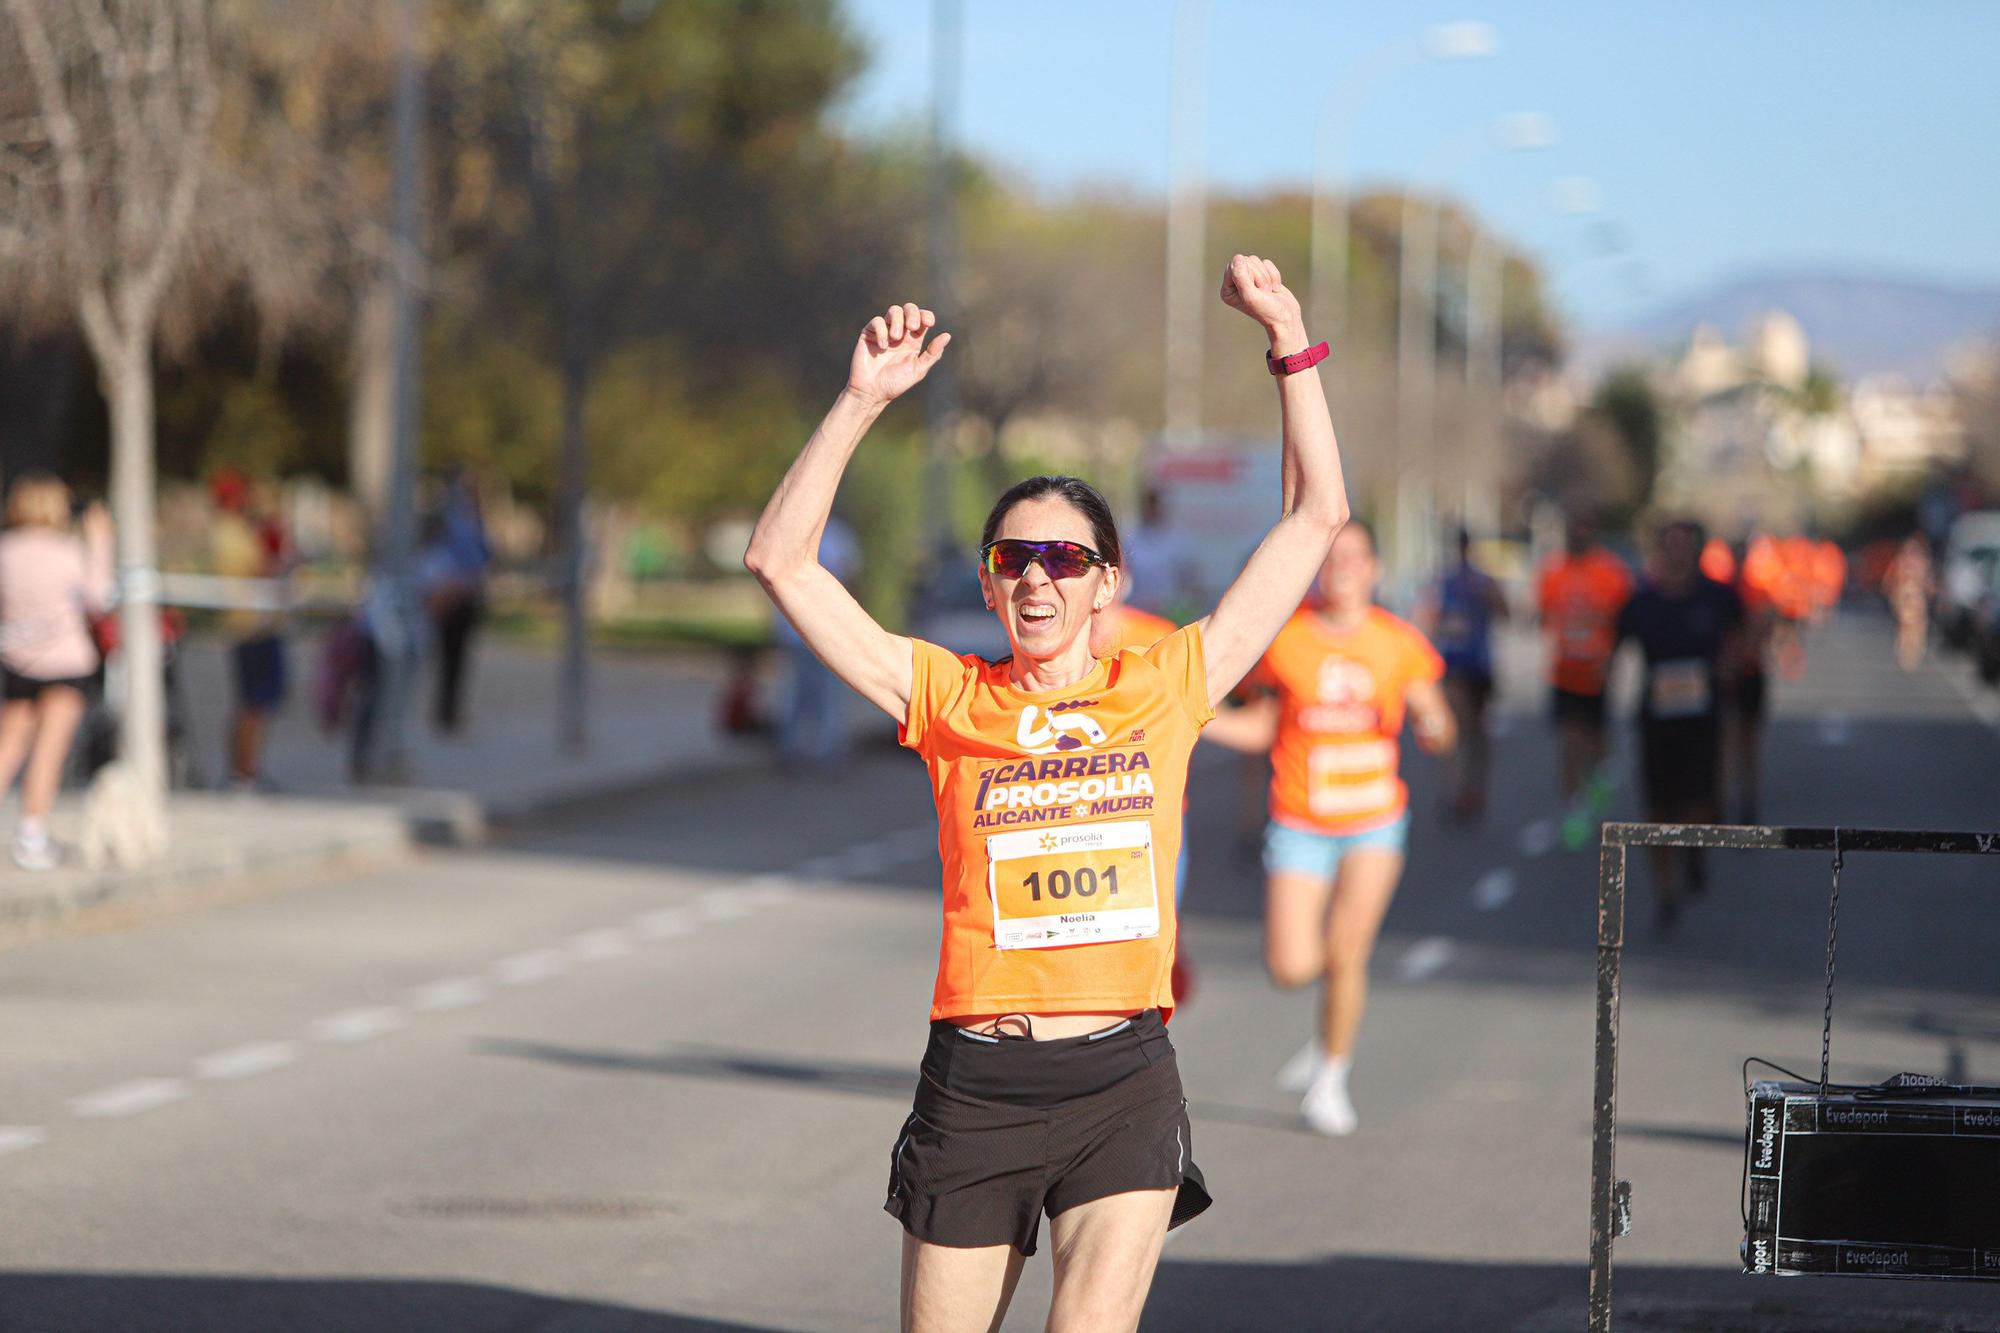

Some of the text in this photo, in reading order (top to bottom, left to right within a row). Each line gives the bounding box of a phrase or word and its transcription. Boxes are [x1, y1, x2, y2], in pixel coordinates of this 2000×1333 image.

[994, 751, 1151, 785] CARRERA
[986, 773, 1154, 811] PROSOLIA
[973, 796, 1154, 829] ALICANTE MUJER
[1060, 832, 1103, 846] prosolia
[1022, 864, 1119, 902] 1001
[1060, 914, 1096, 924] Noelia
[1826, 1107, 1888, 1126] Evedeport
[1755, 1107, 1780, 1168] Evedeport
[1751, 1240, 1772, 1274] eport
[1846, 1250, 1909, 1267] Evedeport
